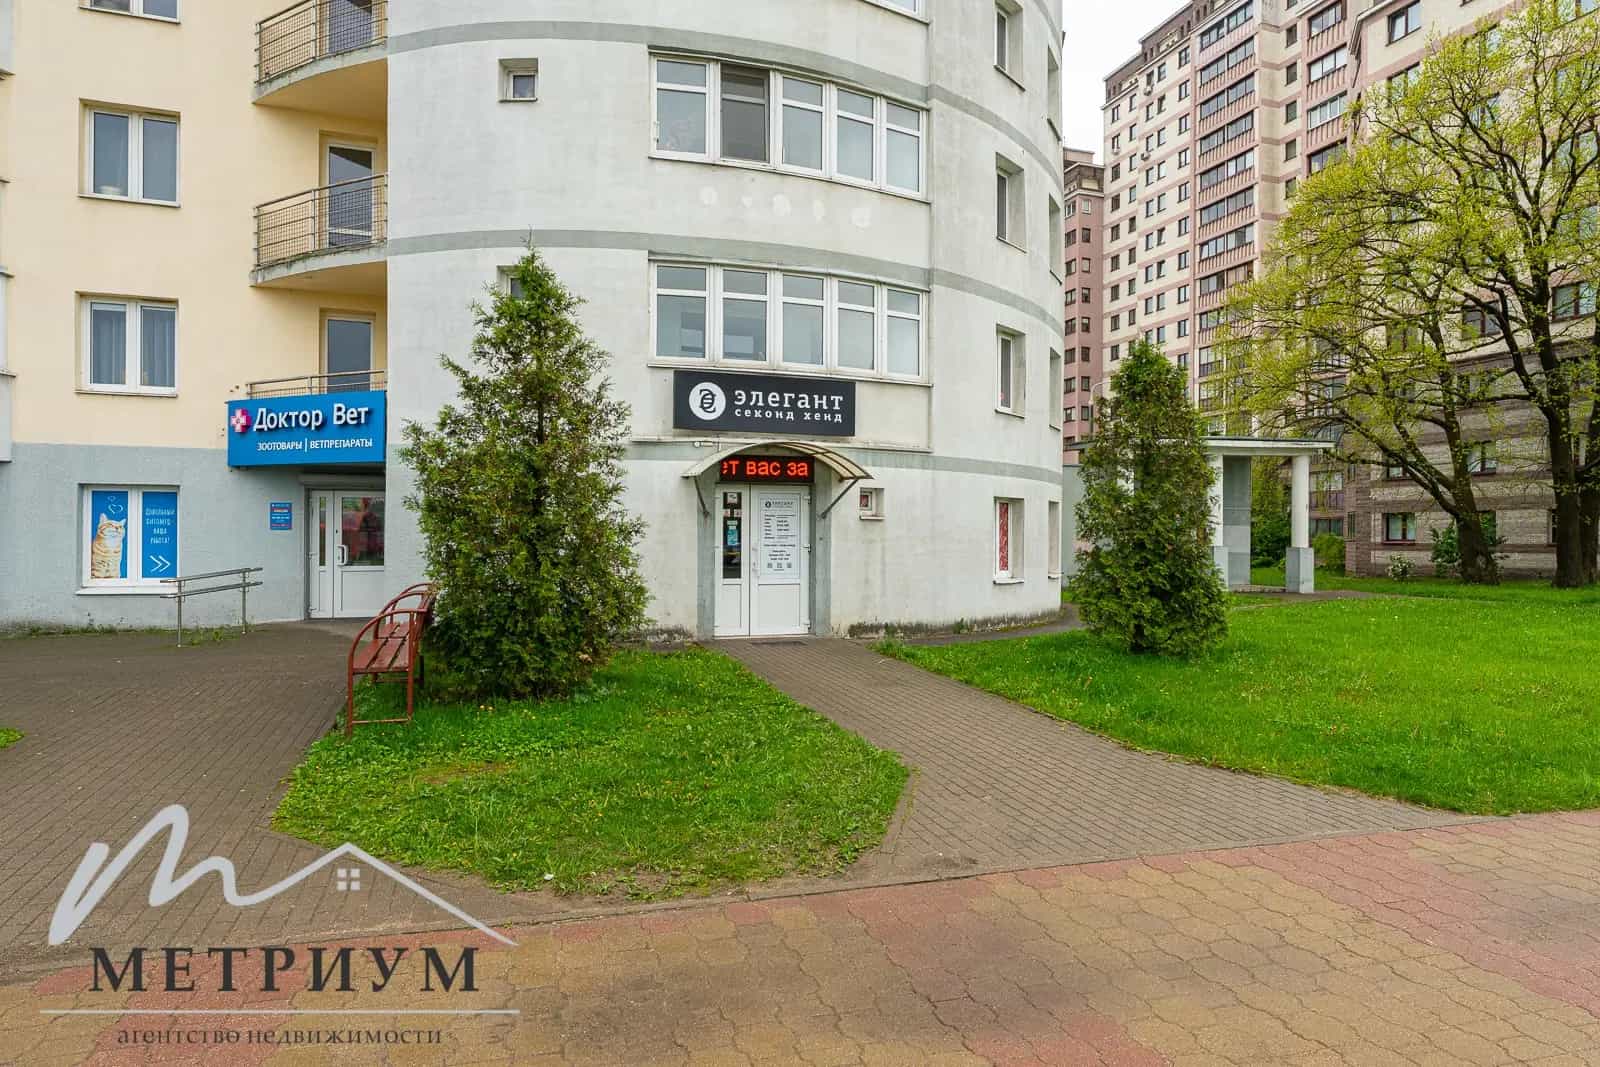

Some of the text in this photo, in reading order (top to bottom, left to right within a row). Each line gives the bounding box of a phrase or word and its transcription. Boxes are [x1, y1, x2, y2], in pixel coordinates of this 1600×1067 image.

[734, 389, 844, 410] элегант
[253, 403, 369, 431] Доктор Вет
[734, 408, 843, 423] секонд хенд
[256, 438, 373, 451] ЗООТОВАРЫ ВЕТПРЕПАРАТЫ
